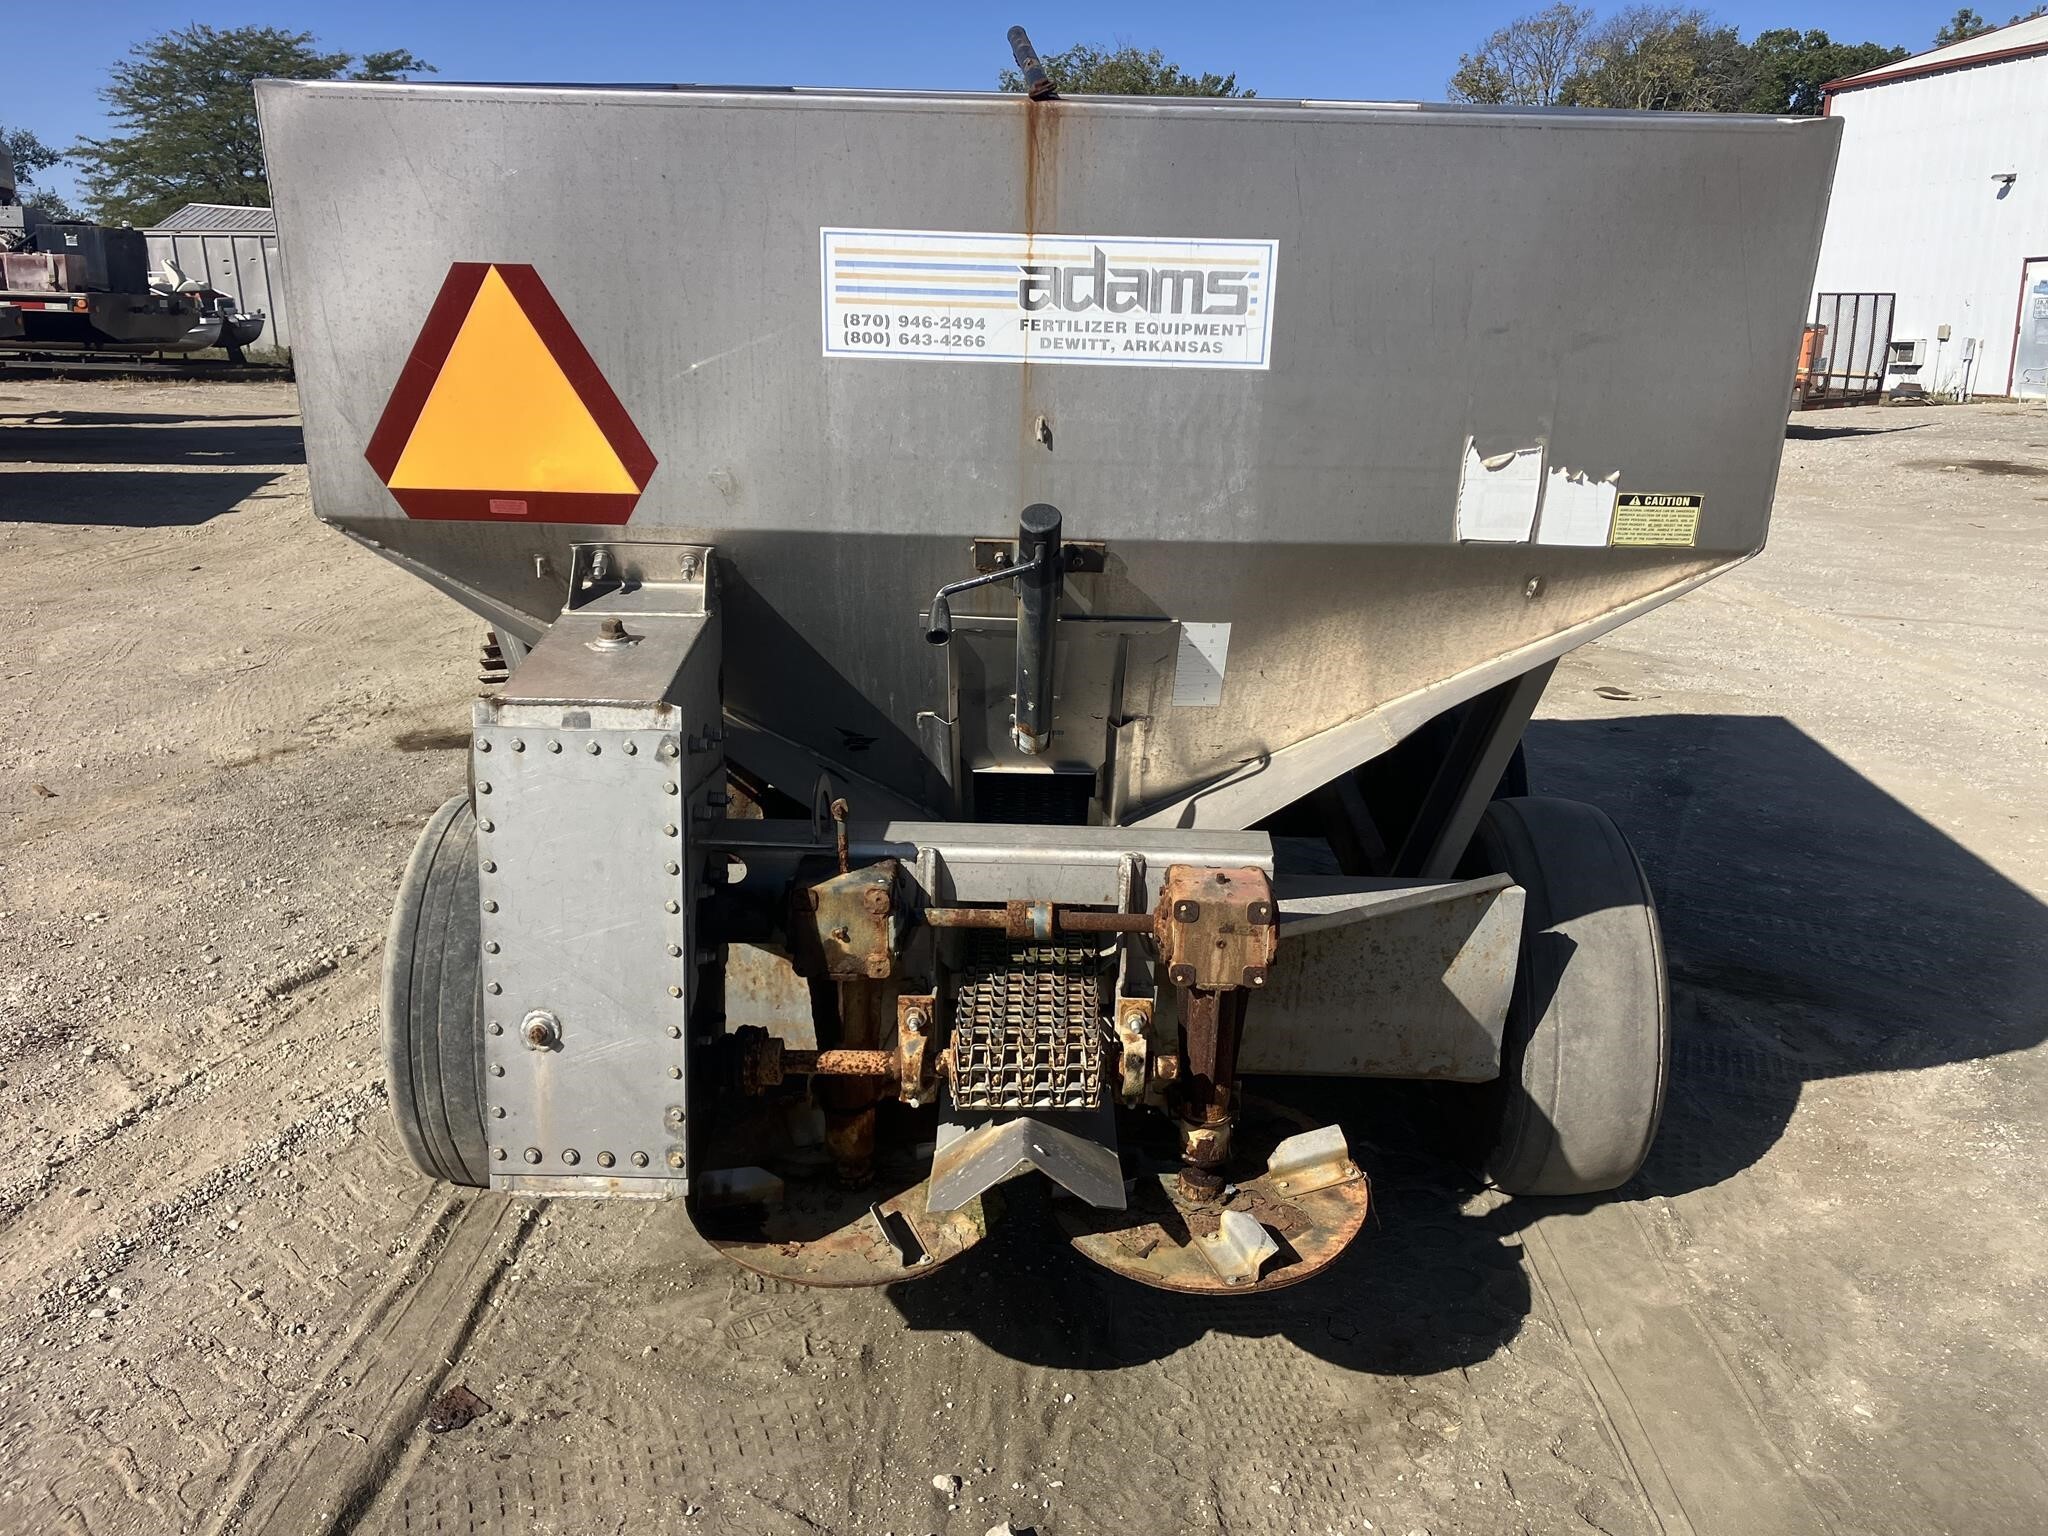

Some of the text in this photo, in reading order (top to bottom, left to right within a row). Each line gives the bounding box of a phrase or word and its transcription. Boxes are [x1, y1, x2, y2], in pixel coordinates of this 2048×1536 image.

[1019, 245, 1249, 315] adams
[843, 313, 986, 331] (870) 946-2494
[1019, 319, 1246, 337] FERTILIZER EQUIPMENT
[843, 331, 986, 348] (800) 643-4266
[1040, 337, 1223, 354] DEWITT, ARKANSAS
[1644, 496, 1691, 506] CAUTION
